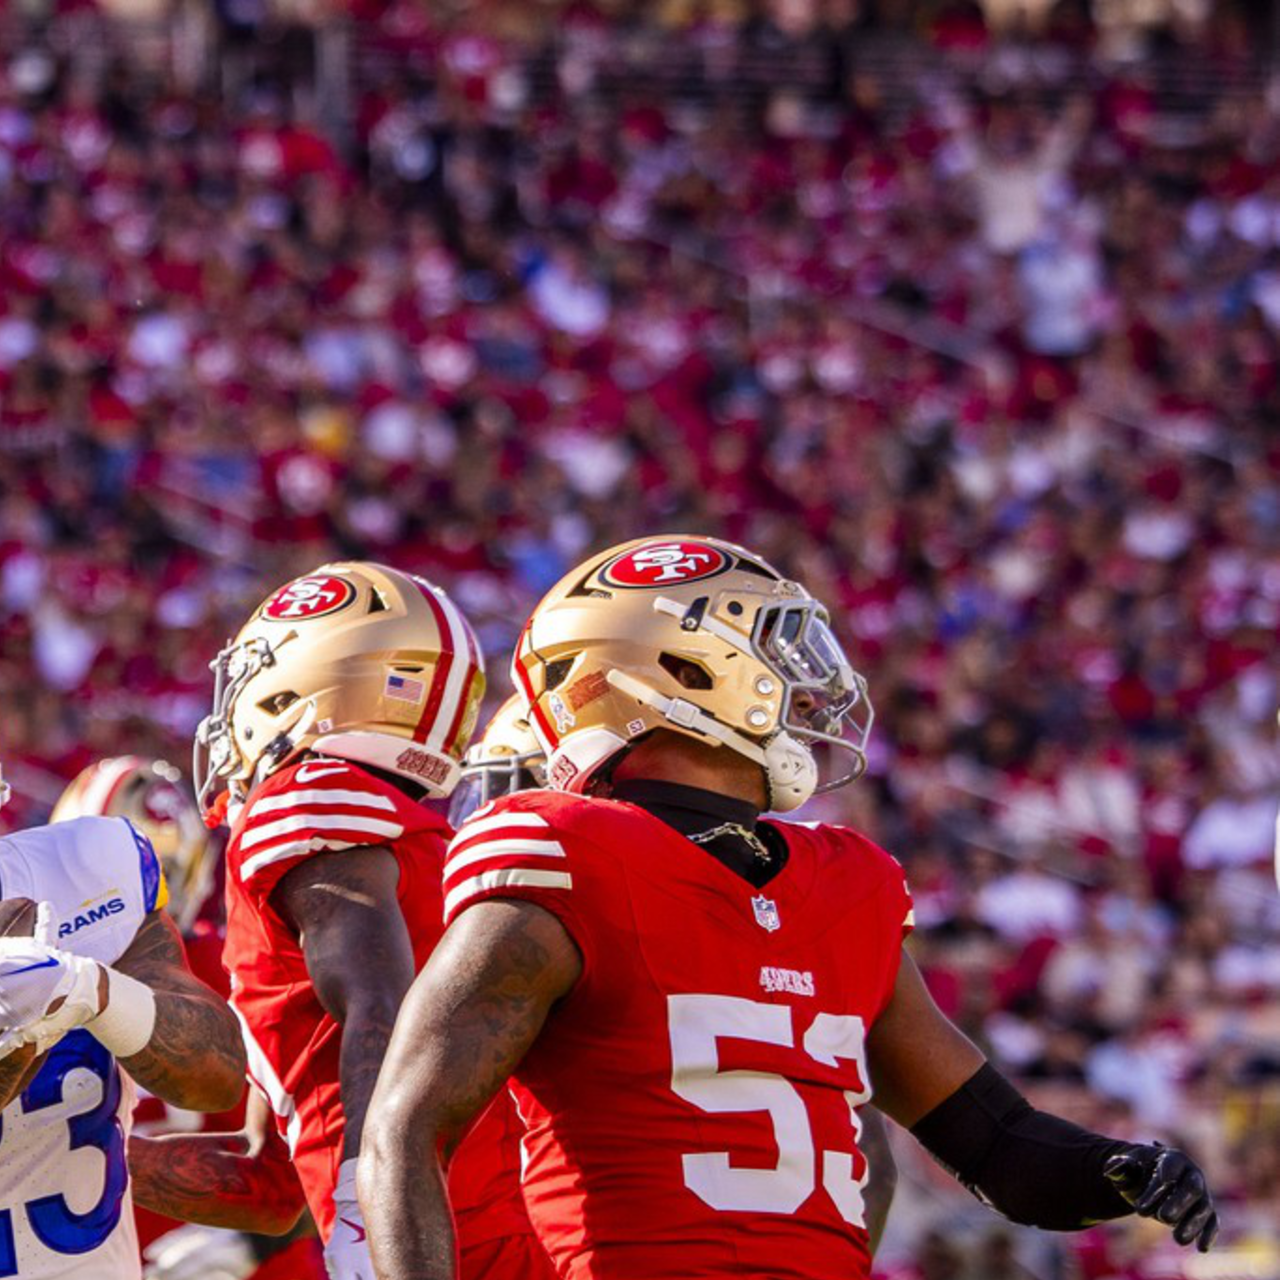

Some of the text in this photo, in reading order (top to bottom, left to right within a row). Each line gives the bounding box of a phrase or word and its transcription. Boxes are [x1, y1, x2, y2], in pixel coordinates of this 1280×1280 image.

[632, 545, 709, 582] SF
[267, 577, 337, 616] SF
[58, 898, 125, 938] RAMS
